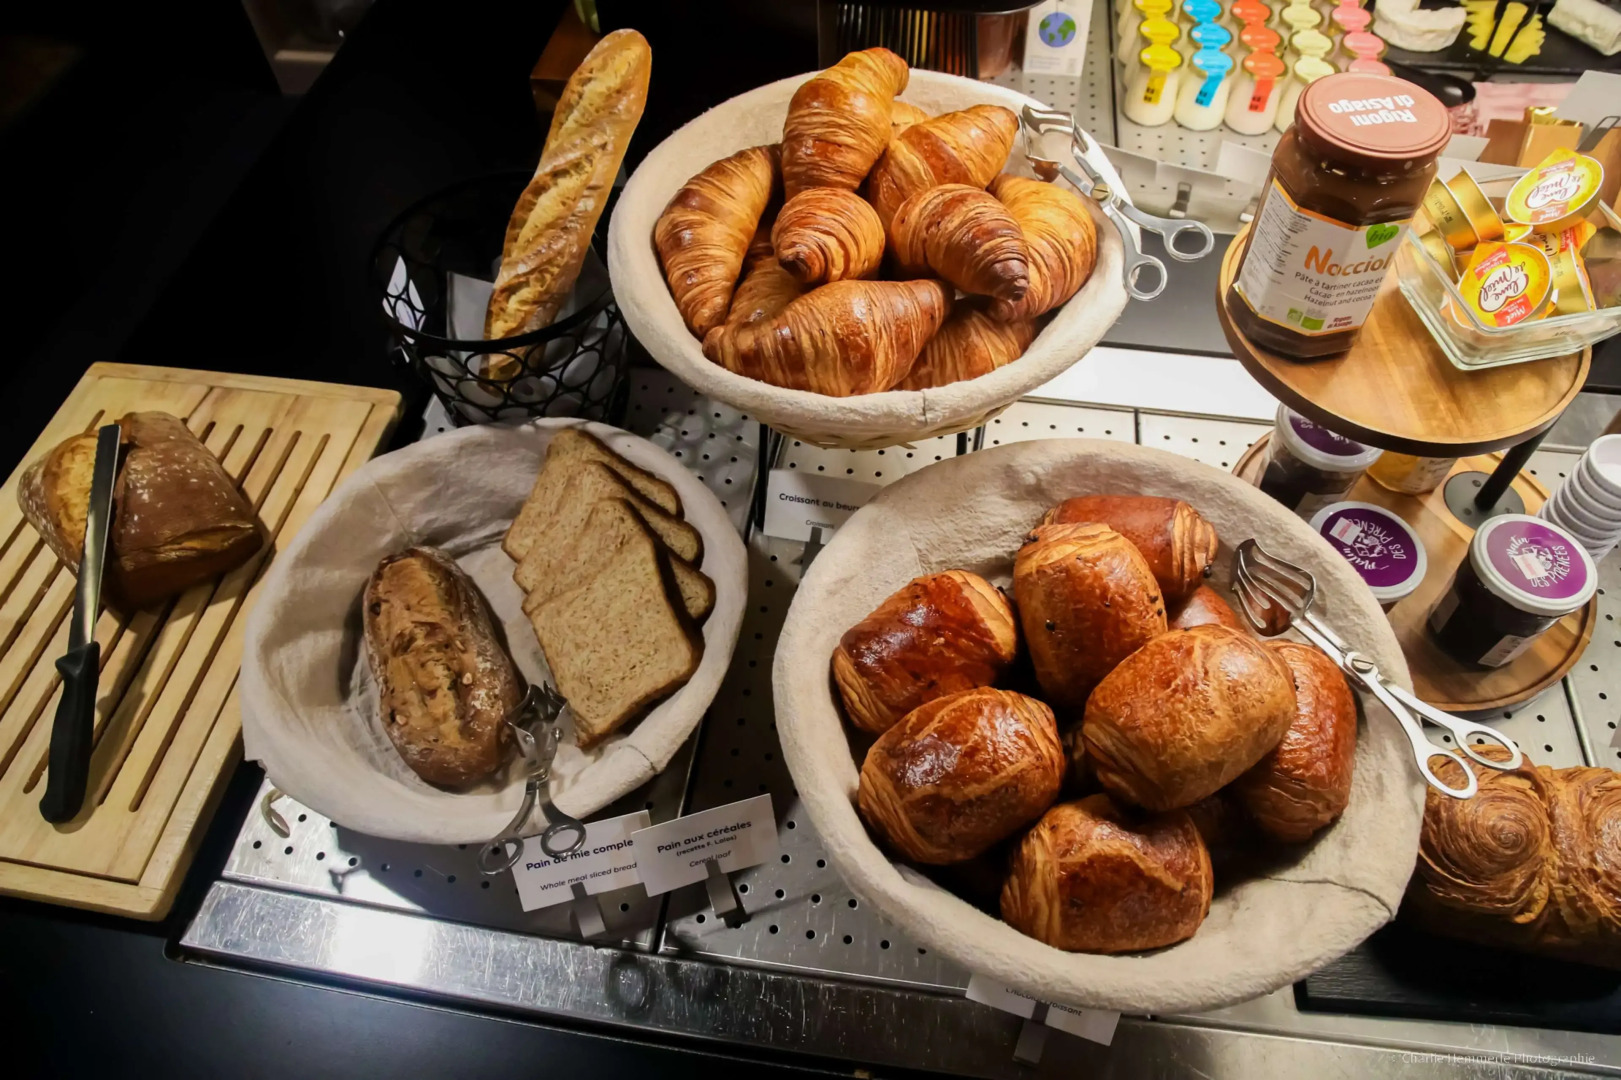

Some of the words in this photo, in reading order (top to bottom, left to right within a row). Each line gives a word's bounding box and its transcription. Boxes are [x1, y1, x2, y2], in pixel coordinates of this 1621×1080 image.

[1328, 96, 1396, 114] Asiago
[1393, 94, 1415, 108] di
[1349, 109, 1418, 127] Rigoni
[1368, 228, 1394, 243] bio
[1304, 245, 1394, 276] Nocciol
[1304, 294, 1337, 307] Hazelnut
[779, 492, 820, 507] Croissant
[822, 499, 834, 509] au
[835, 500, 861, 512] beurr
[1388, 543, 1407, 560] DES
[657, 841, 681, 854] Pain
[683, 834, 705, 845] aux
[706, 821, 752, 838] céréales
[525, 859, 551, 871] Pain
[553, 853, 568, 864] de
[570, 849, 591, 860] mie
[592, 839, 634, 855] comple
[676, 844, 706, 857] (recette
[689, 854, 716, 867] Cereal
[715, 850, 732, 861] loaf
[540, 880, 566, 891] Whole
[567, 873, 588, 884] meal
[589, 868, 612, 879] sliced
[613, 862, 638, 873] bread
